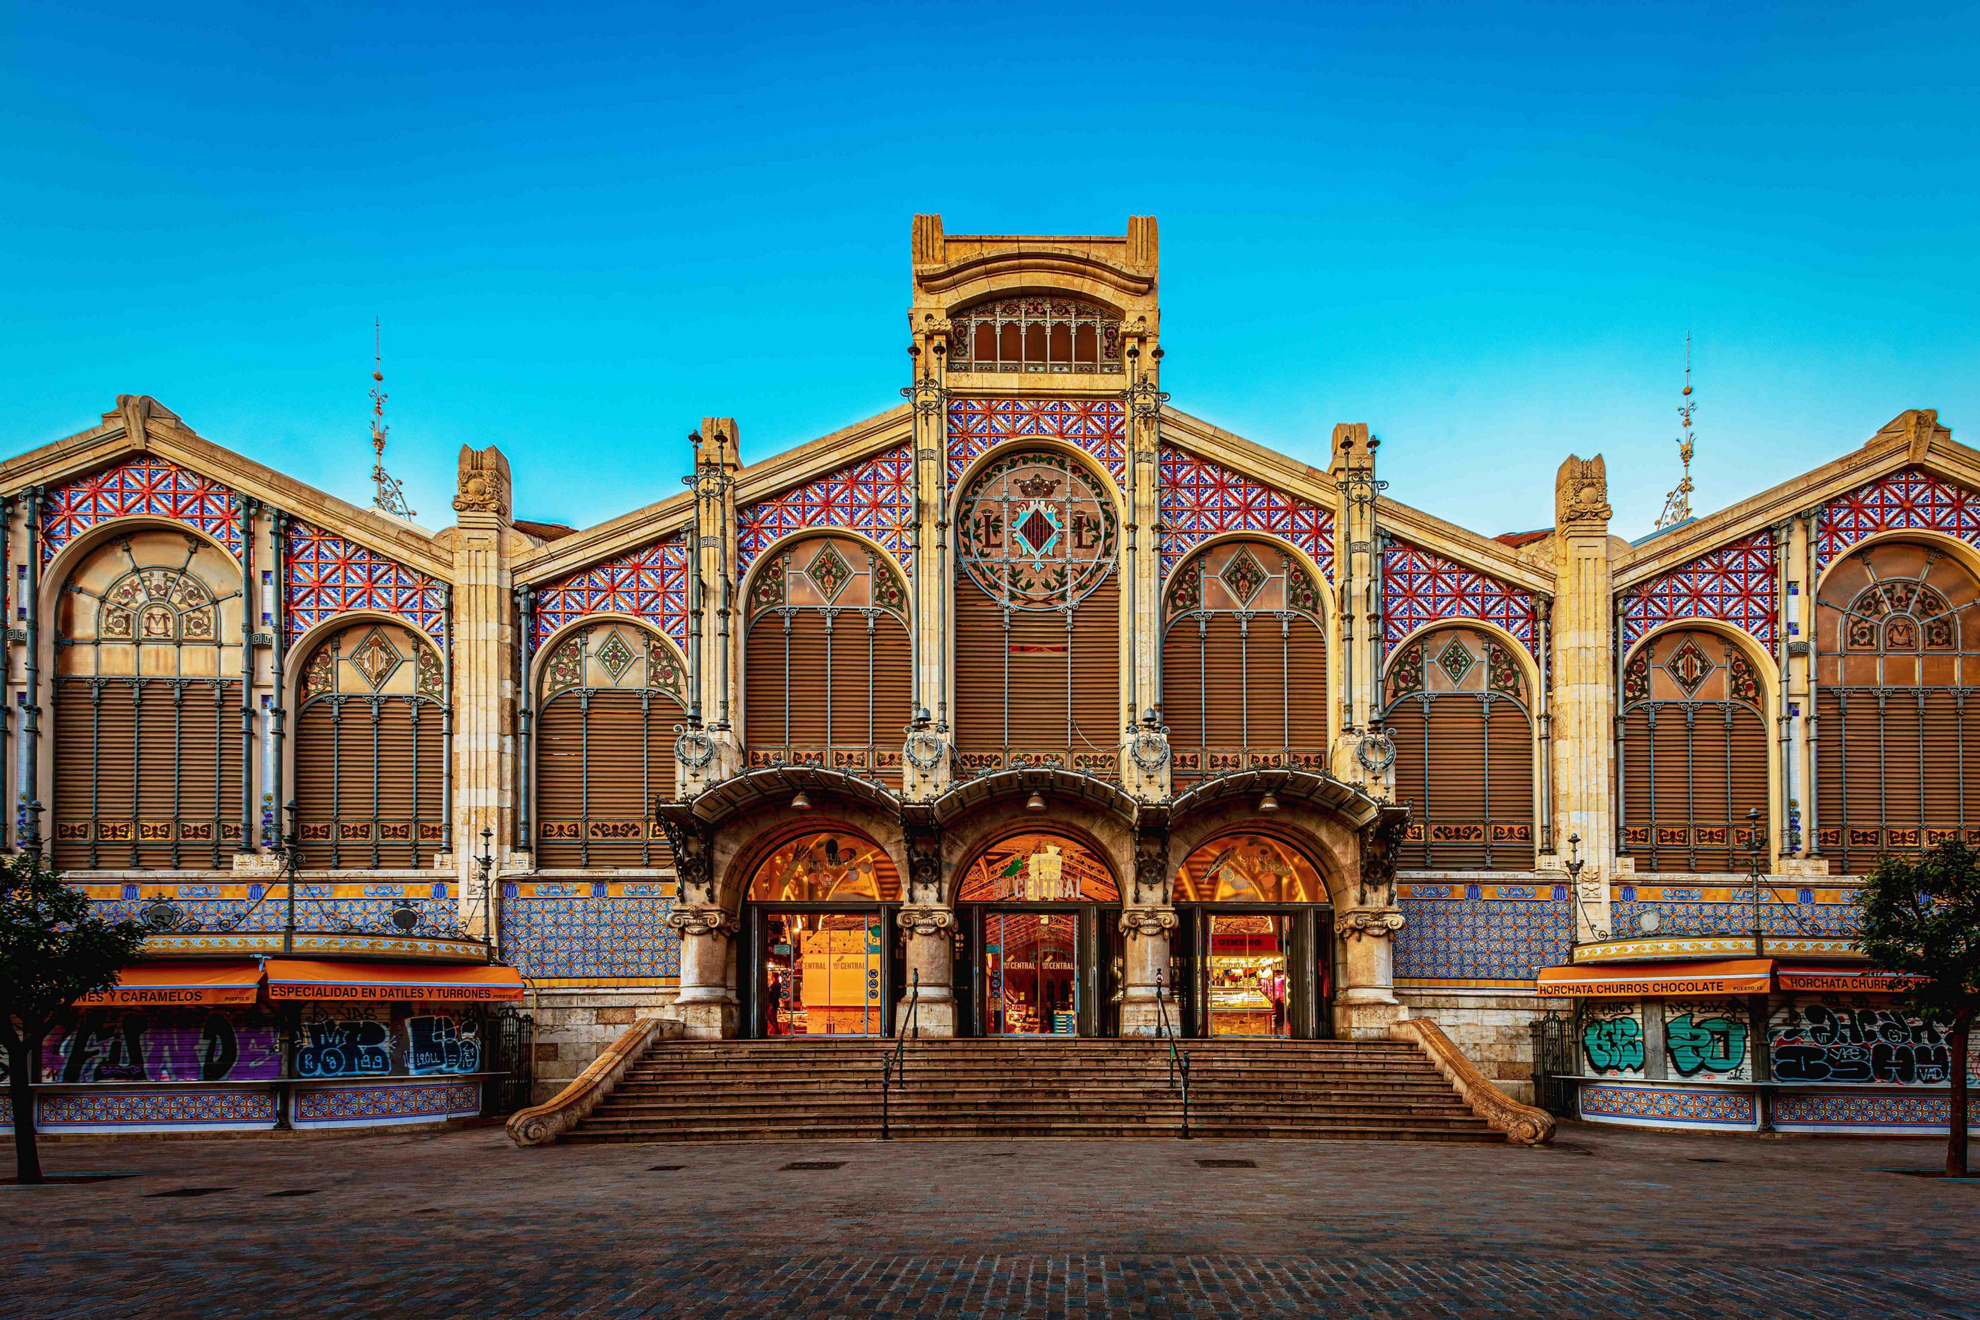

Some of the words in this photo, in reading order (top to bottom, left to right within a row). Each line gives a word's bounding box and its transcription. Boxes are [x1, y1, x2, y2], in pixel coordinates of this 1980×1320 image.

[1014, 878, 1085, 898] CENTRAL
[802, 962, 826, 970] CENTRAL
[841, 962, 866, 970] CENTRAL
[1010, 962, 1036, 970] CENTRAL
[1049, 962, 1074, 970] CENTRAL
[1540, 984, 1594, 995] HORCHATA
[1596, 983, 1649, 994] CHURROS
[1652, 981, 1724, 993] CHOCOLATE
[1790, 978, 1849, 989] HORCHATA
[1851, 978, 1901, 990] CHURR
[109, 992, 118, 1002] Y
[120, 990, 203, 1002] CARAMELOS
[271, 986, 358, 998] ESPECIALIDAD
[361, 988, 376, 998] EN
[380, 988, 424, 998] DATILES
[426, 988, 434, 998] Y
[436, 988, 491, 999] TURRONES
